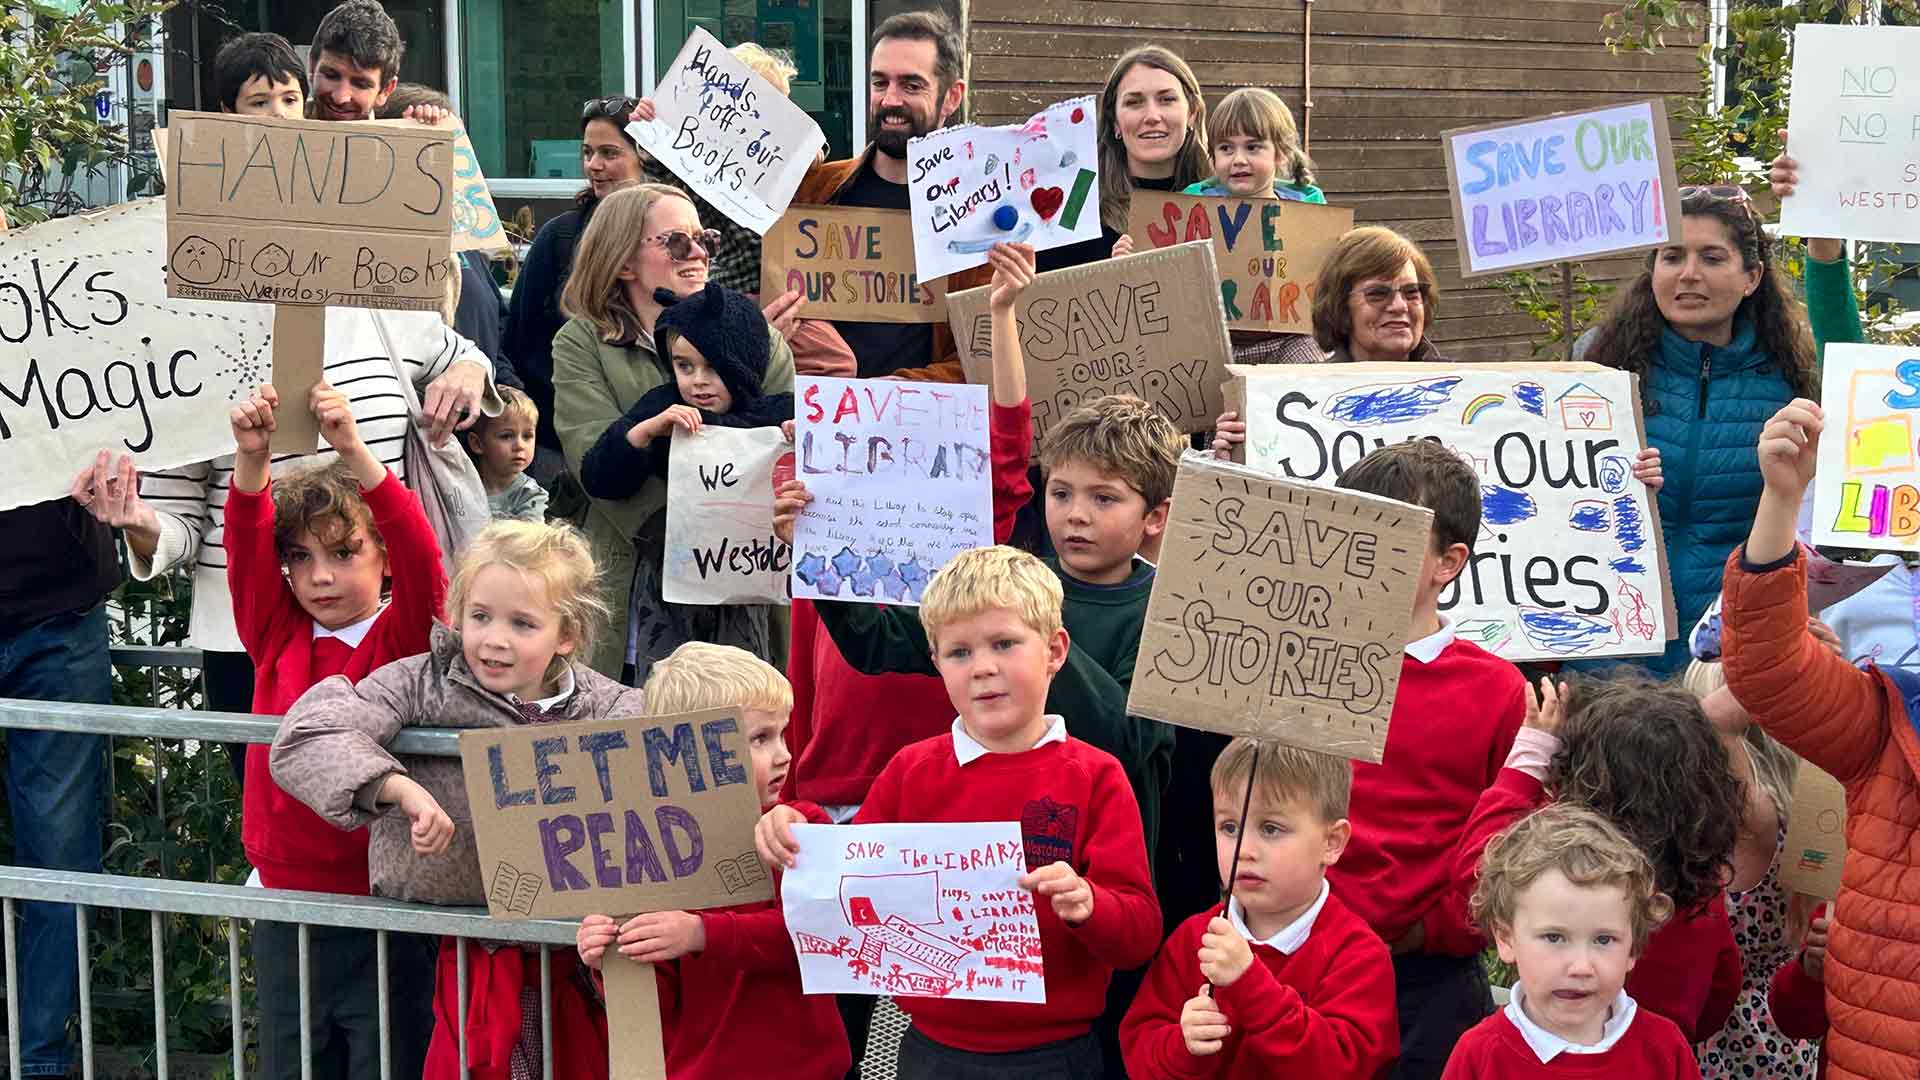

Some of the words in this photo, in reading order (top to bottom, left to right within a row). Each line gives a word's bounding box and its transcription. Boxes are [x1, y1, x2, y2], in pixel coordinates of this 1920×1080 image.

[1840, 65, 1897, 97] NO
[1462, 135, 1566, 194] SAVE
[1575, 118, 1654, 173] OUR
[1839, 112, 1887, 143] NO
[177, 128, 444, 215] HANDS
[912, 146, 954, 183] Save
[931, 162, 1012, 233] Library!
[1147, 201, 1283, 253] SAVE
[1472, 177, 1663, 257] LIBRARY!
[795, 218, 882, 259] SAVE
[1248, 256, 1287, 279] OUR
[786, 268, 837, 303] OUR
[842, 268, 936, 306] STORIES
[1025, 281, 1169, 361] SAVE
[1072, 352, 1134, 383] OUR
[803, 384, 928, 427] SAVE
[1277, 391, 1442, 480] Sa
[1494, 431, 1620, 489] our
[1212, 497, 1377, 579] SAVE
[1247, 576, 1332, 628] OUR
[1154, 600, 1391, 714] STORIES
[486, 729, 629, 810] LET
[642, 718, 747, 797] ME
[537, 805, 705, 892] READ
